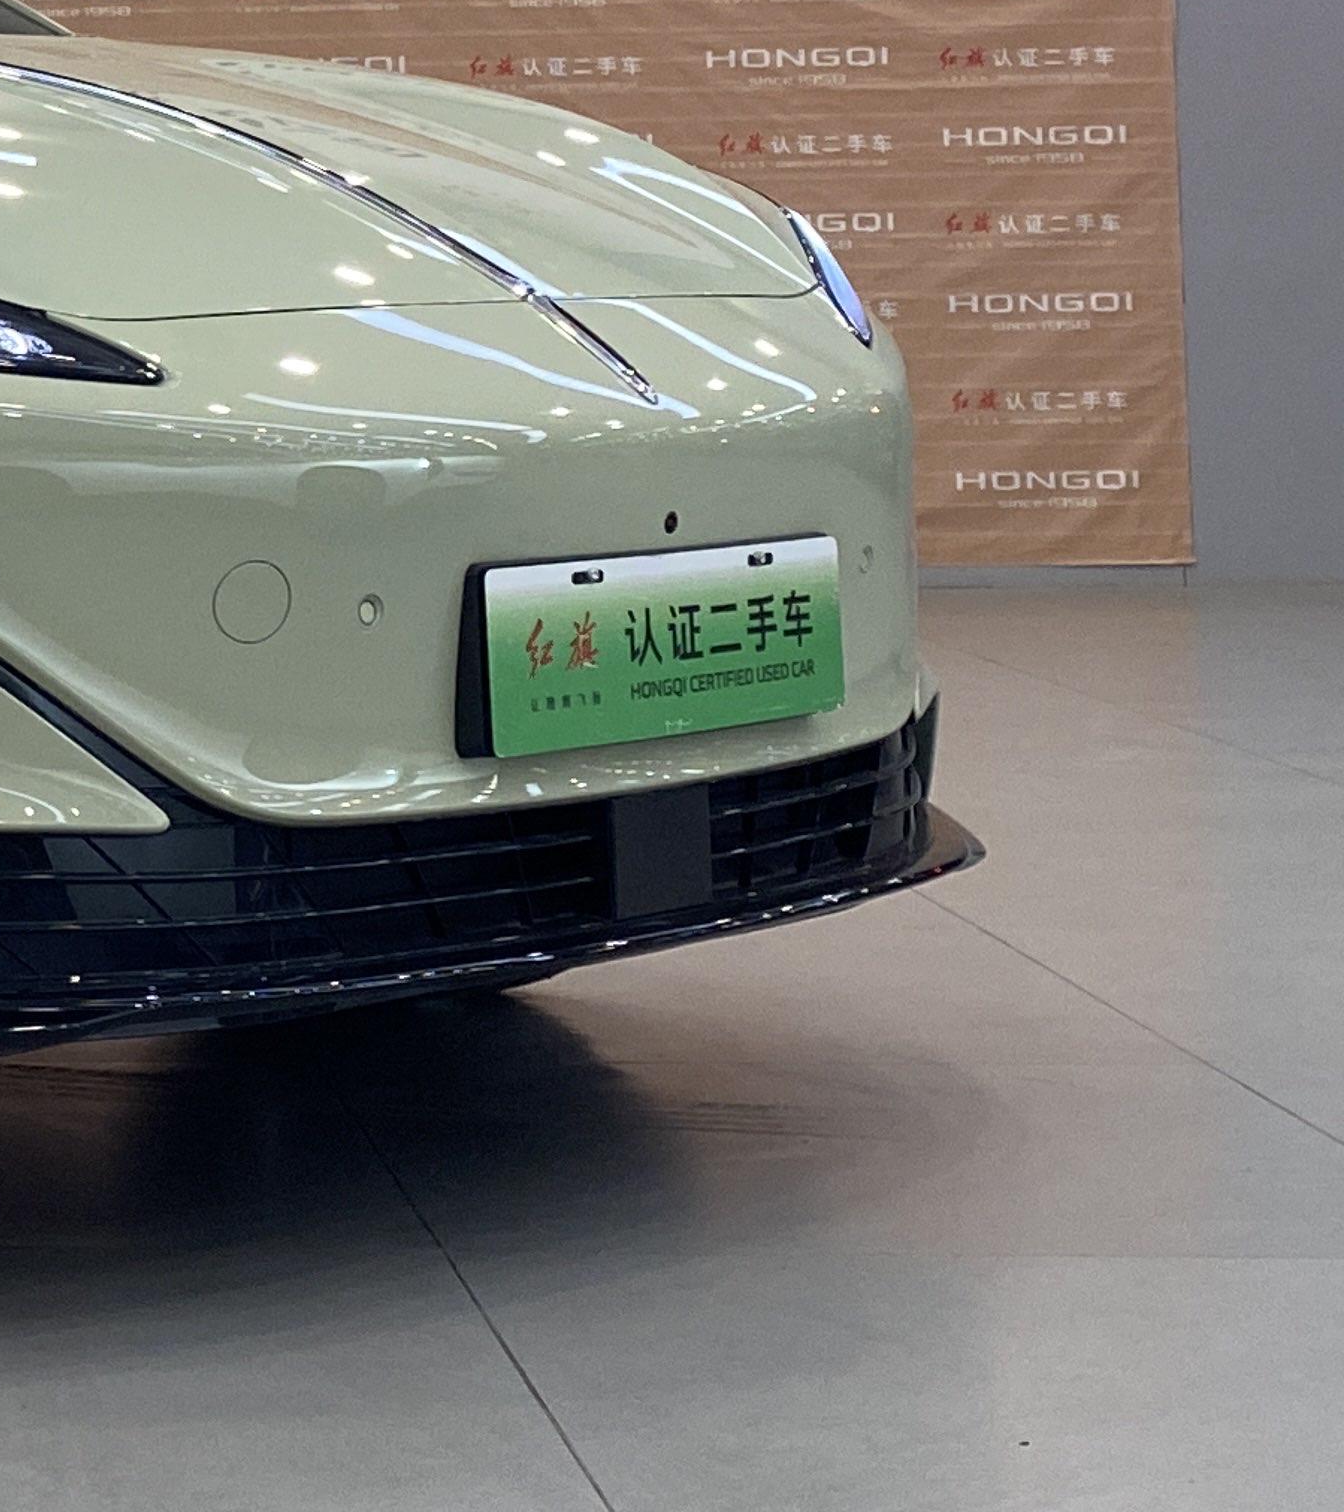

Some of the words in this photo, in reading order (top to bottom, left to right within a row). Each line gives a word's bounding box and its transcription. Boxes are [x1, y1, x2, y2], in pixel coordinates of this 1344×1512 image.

[706, 47, 888, 68] HONGQI
[943, 124, 1126, 147] HONGQI
[948, 292, 1132, 313] HONGQI
[955, 470, 1138, 490] HONGQI
[630, 677, 688, 701] HONGQI
[690, 667, 754, 693] CERTIFIED
[756, 662, 790, 683] USED
[791, 658, 816, 679] CAR
